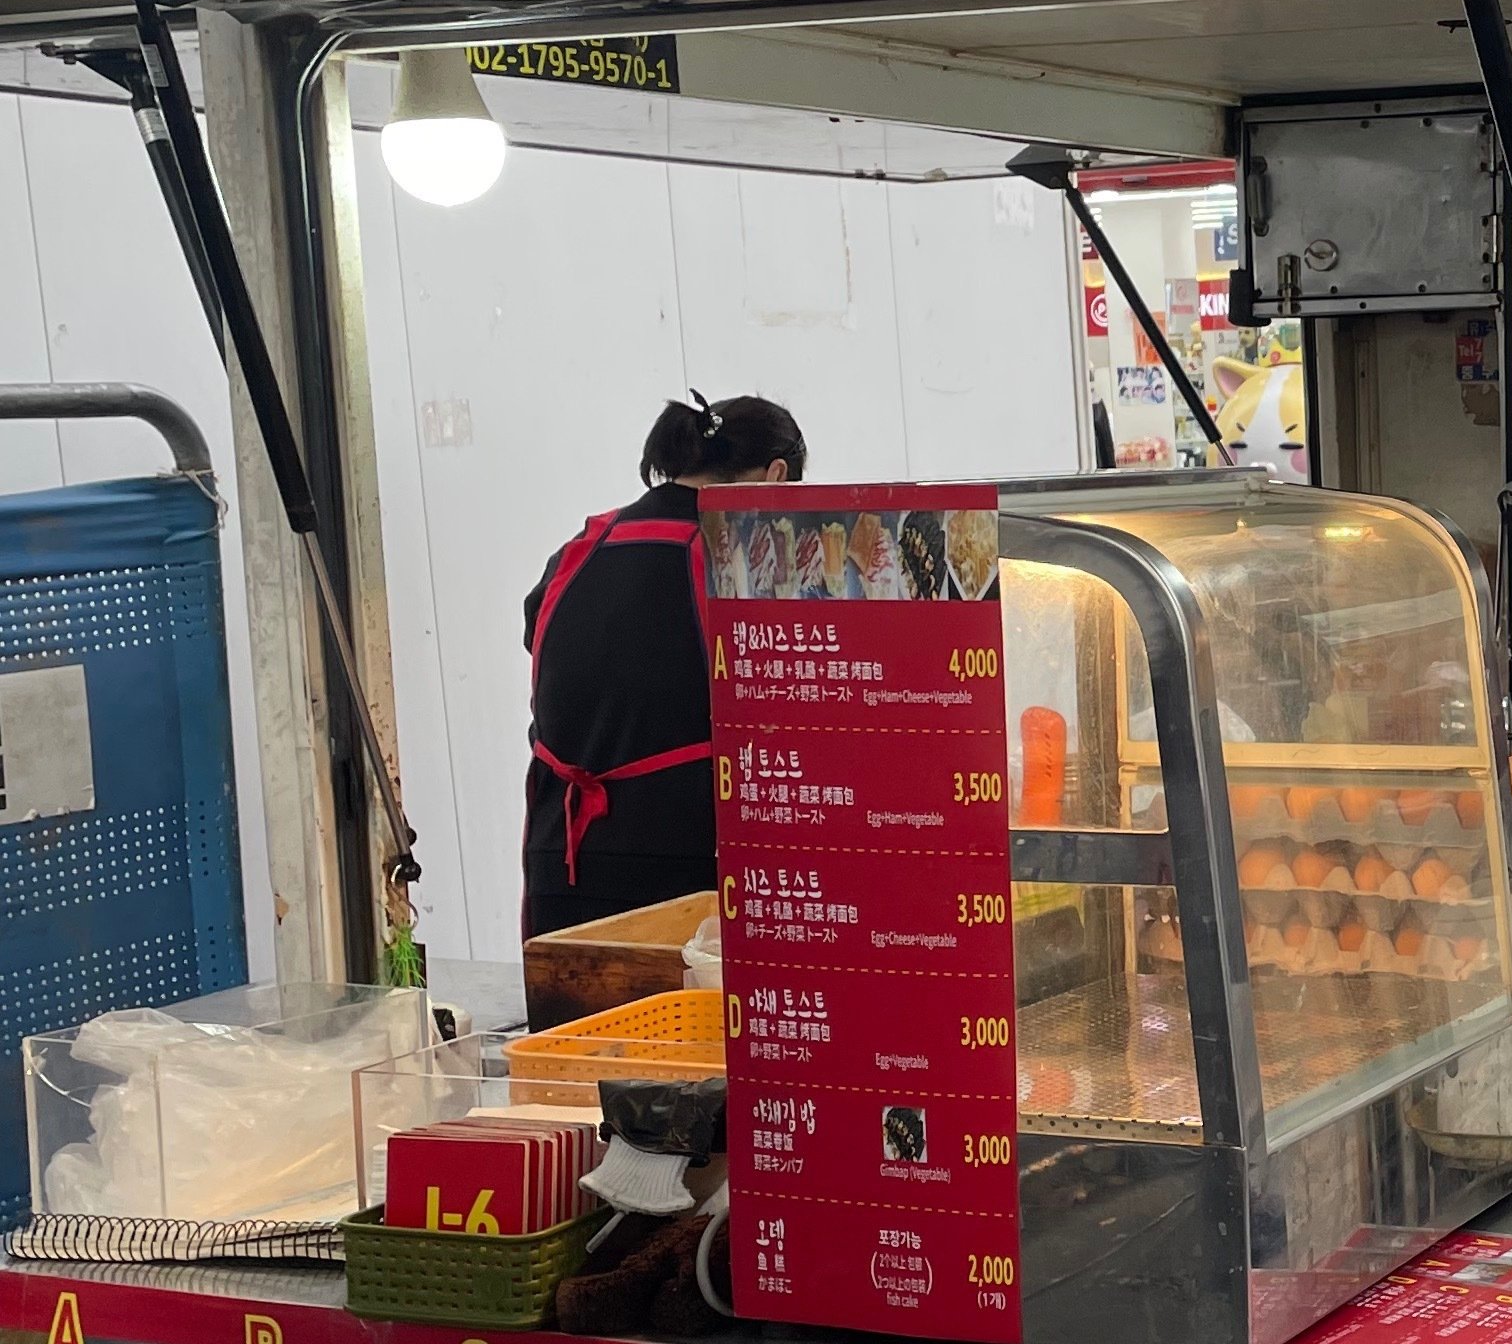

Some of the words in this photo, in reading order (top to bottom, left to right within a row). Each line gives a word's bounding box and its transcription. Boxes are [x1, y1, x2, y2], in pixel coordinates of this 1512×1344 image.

[792, 624, 840, 652] 토스트
[714, 635, 728, 681] A
[949, 648, 998, 682] 4,000
[718, 756, 732, 801] B
[758, 748, 802, 778] 토스트
[953, 772, 1002, 806] 3,500
[723, 875, 738, 920] C
[743, 868, 772, 897] 치즈
[776, 869, 823, 899] 토스트
[957, 894, 1005, 927] 3,500
[728, 994, 742, 1039] D
[749, 987, 777, 1015] 야채
[781, 989, 827, 1019] 토스트
[960, 1016, 1009, 1050] 3,000
[963, 1134, 1010, 1167] 3,000
[756, 1219, 785, 1251] 오뎅
[879, 1228, 922, 1250] 포장가능
[968, 1254, 1014, 1287] 2,000
